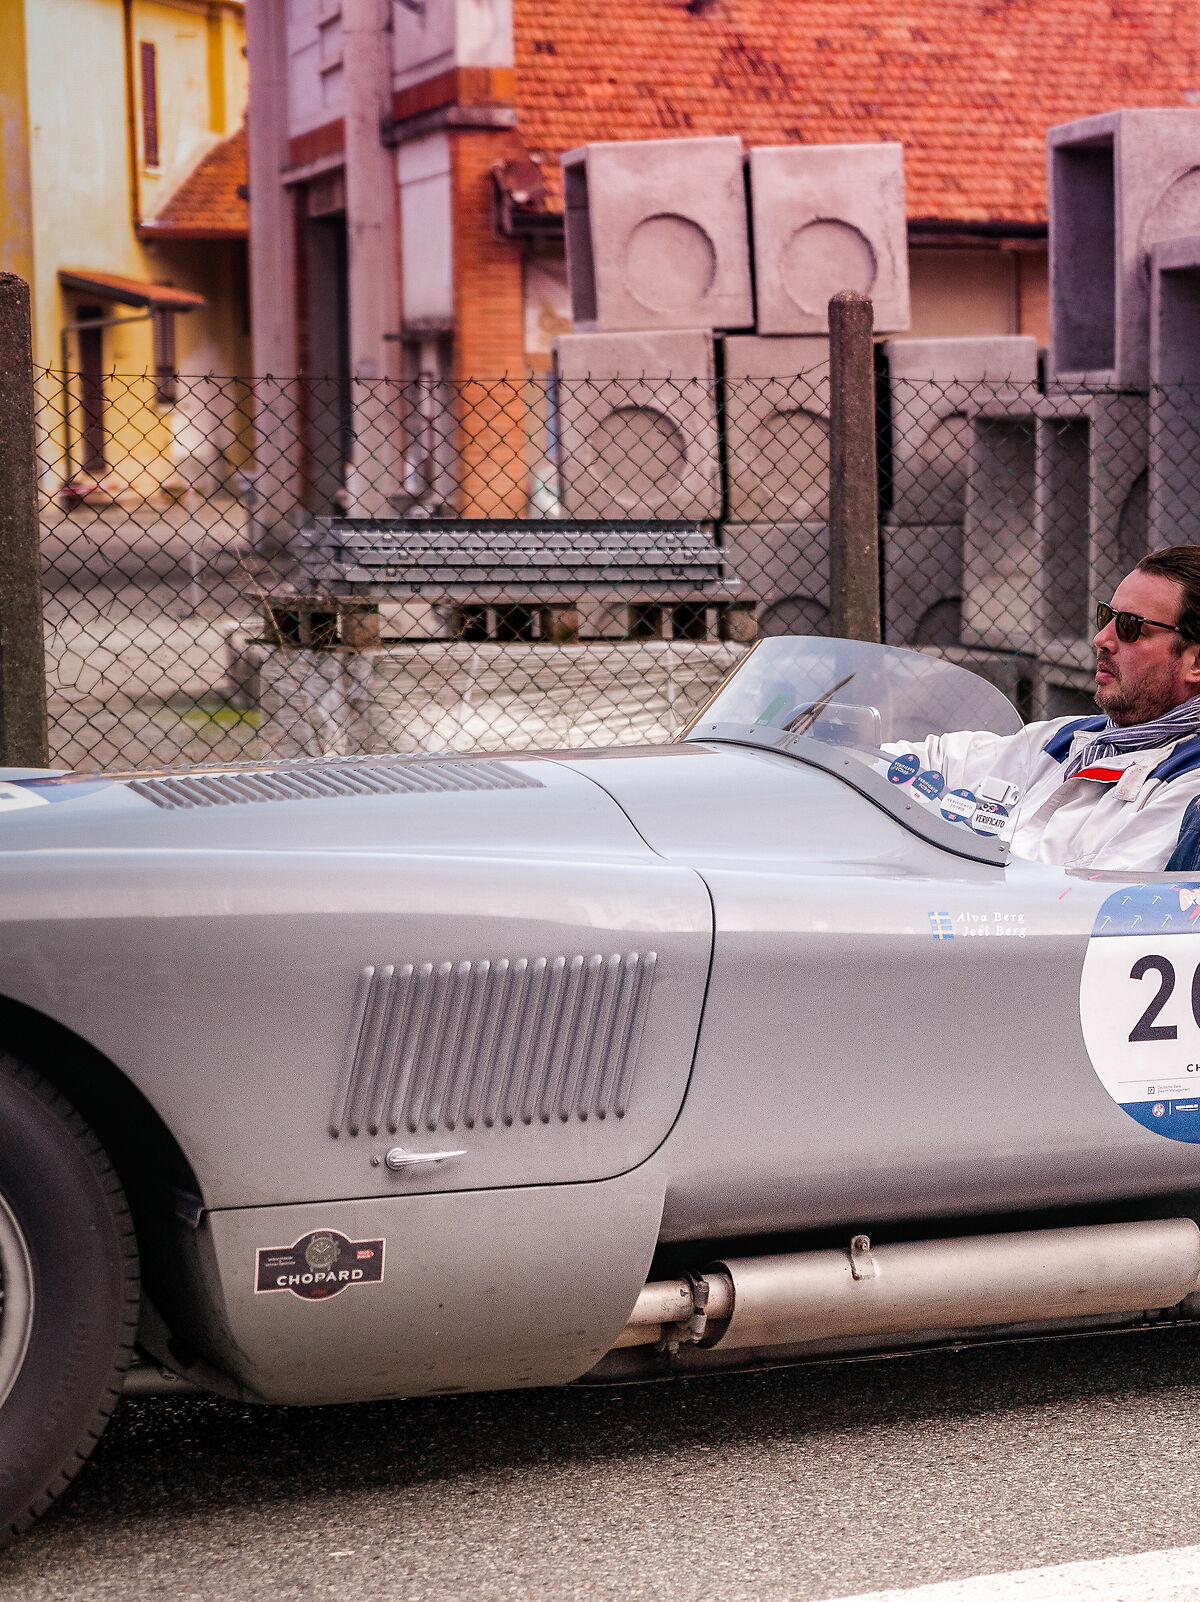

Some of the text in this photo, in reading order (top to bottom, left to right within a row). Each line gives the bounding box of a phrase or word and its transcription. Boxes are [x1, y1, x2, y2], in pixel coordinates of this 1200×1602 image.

[918, 777, 938, 794] VERIFICATO
[976, 814, 1005, 829] VERIFICATO
[956, 911, 1025, 924] Alva Berg
[962, 925, 1026, 939] Joel Berg
[276, 1269, 364, 1286] CHOPARD
